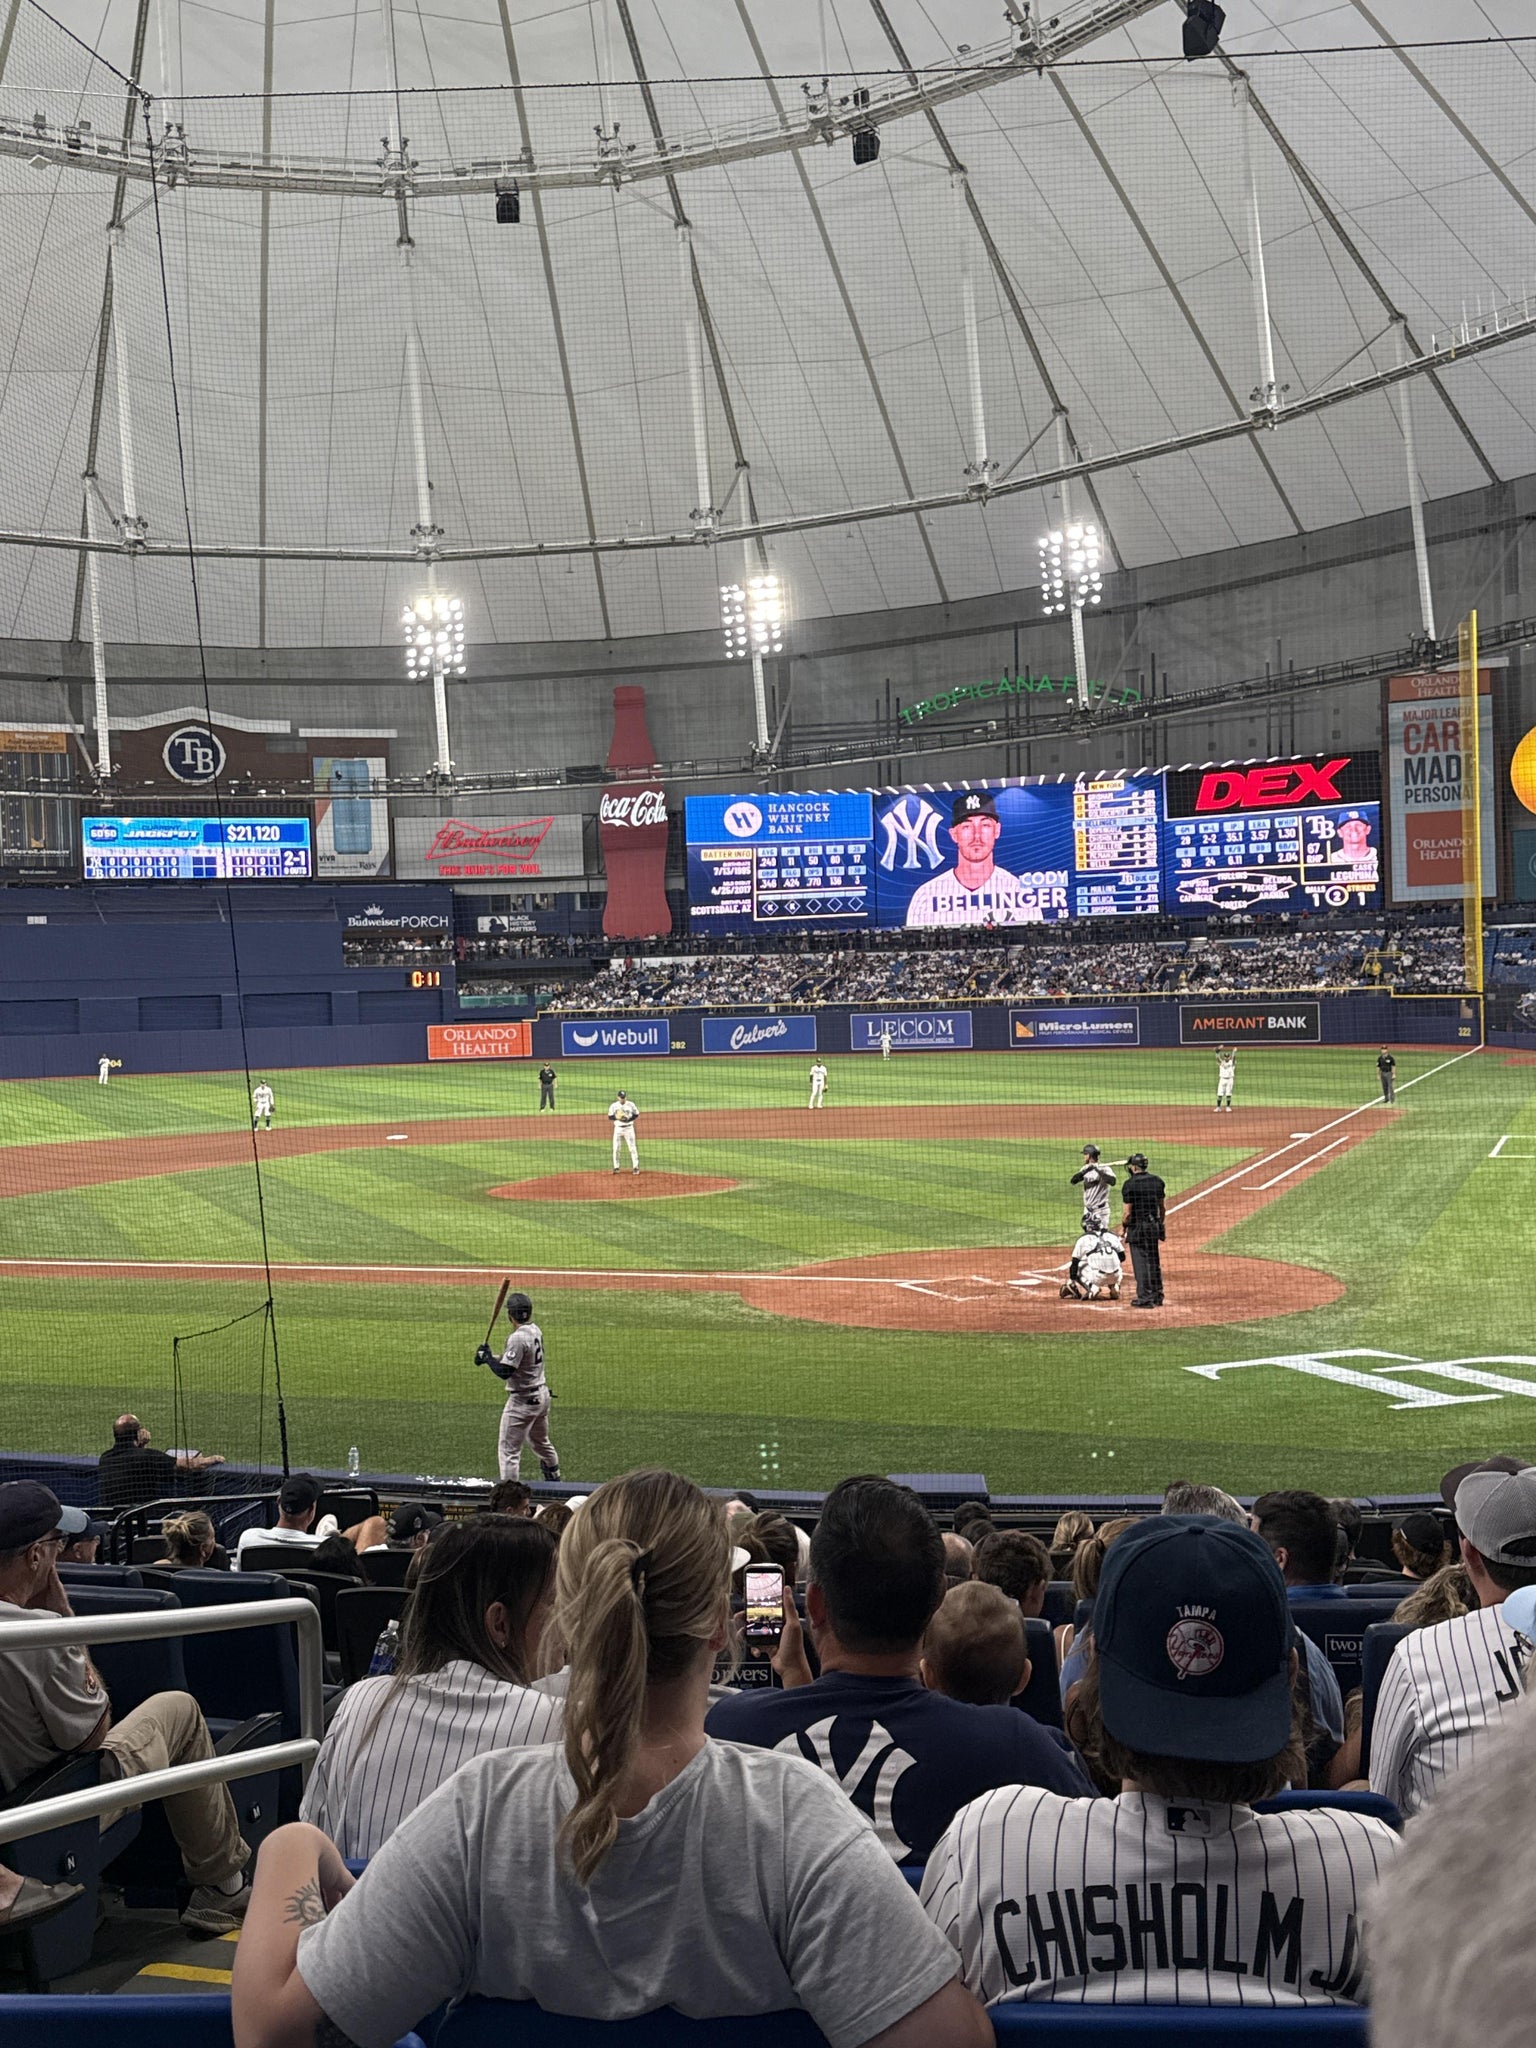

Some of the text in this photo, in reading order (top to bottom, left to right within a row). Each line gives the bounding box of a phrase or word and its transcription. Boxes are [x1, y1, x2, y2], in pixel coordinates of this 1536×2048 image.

[1411, 675, 1468, 688] ORLANDO
[1418, 686, 1464, 698] HEALTH
[898, 675, 1054, 725] TROPICANA
[1403, 706, 1473, 721] MAJOR LEAGU
[174, 738, 216, 774] TB
[1195, 758, 1351, 811] DEX
[600, 790, 668, 827] Coca-Cola
[768, 803, 830, 812] HANCOCK
[768, 813, 830, 823] WHITNEY
[1278, 818, 1296, 826] WHIP
[123, 830, 199, 839] JACKPOT
[227, 824, 280, 843] $21,120
[768, 825, 803, 834] BANK
[880, 799, 945, 871] NY
[1202, 828, 1296, 844] 2-2 35.1 3.57 1.30
[437, 830, 542, 849] Budweiser
[1413, 837, 1472, 850] ORLANDO
[734, 850, 751, 858] INFO
[1307, 843, 1320, 854] 67
[1420, 849, 1466, 861] HEALTH
[109, 857, 277, 866] 0 0 0 0 3 0 1 0 0 1
[283, 850, 306, 866] 2-1
[788, 857, 794, 866] 11
[808, 856, 818, 865] 50
[853, 854, 861, 863] 17
[1205, 857, 1216, 867] 24
[1277, 852, 1298, 862] 2.04
[109, 868, 115, 877] 0
[122, 868, 128, 877] 0
[135, 868, 140, 877] 0
[147, 868, 152, 877] 0
[159, 868, 164, 876] 1
[171, 868, 177, 876] 0
[235, 867, 241, 875] 3
[248, 867, 253, 875] 0
[261, 867, 266, 875] 2
[273, 867, 277, 875] 1
[290, 867, 307, 875] OUTS
[439, 865, 462, 876] THIS
[464, 864, 494, 875] BUD'S
[497, 864, 516, 875] FOR
[713, 866, 751, 876] 7/13/1995
[1331, 871, 1378, 880] LEGUMINA
[854, 875, 860, 885] 3
[1021, 871, 1068, 885] CODY
[711, 886, 751, 895] 4/25/2017
[1305, 886, 1326, 894] BALLS
[937, 887, 1067, 911] BELLINGER
[1312, 890, 1365, 907] 1 2 1
[691, 904, 752, 916] SCOTTSDALE, AZ
[1058, 908, 1069, 919] 35
[347, 915, 448, 928] Budweiser PORCH
[509, 925, 537, 933] MATTERS
[411, 970, 440, 988] 0:11
[867, 1019, 954, 1037] LECOM
[1039, 1022, 1133, 1031] MicroLumen
[1193, 1016, 1306, 1030] AMERANT BANK
[443, 1028, 517, 1042] ORLANDO
[601, 1028, 658, 1046] Webull
[730, 1019, 788, 1050] Culver's
[453, 1042, 509, 1055] HEALTH
[671, 1041, 686, 1050] 382
[1176, 1604, 1217, 1620] TAMPA
[1330, 1638, 1357, 1651] two
[994, 1882, 1369, 2000] CHISHOLM J
